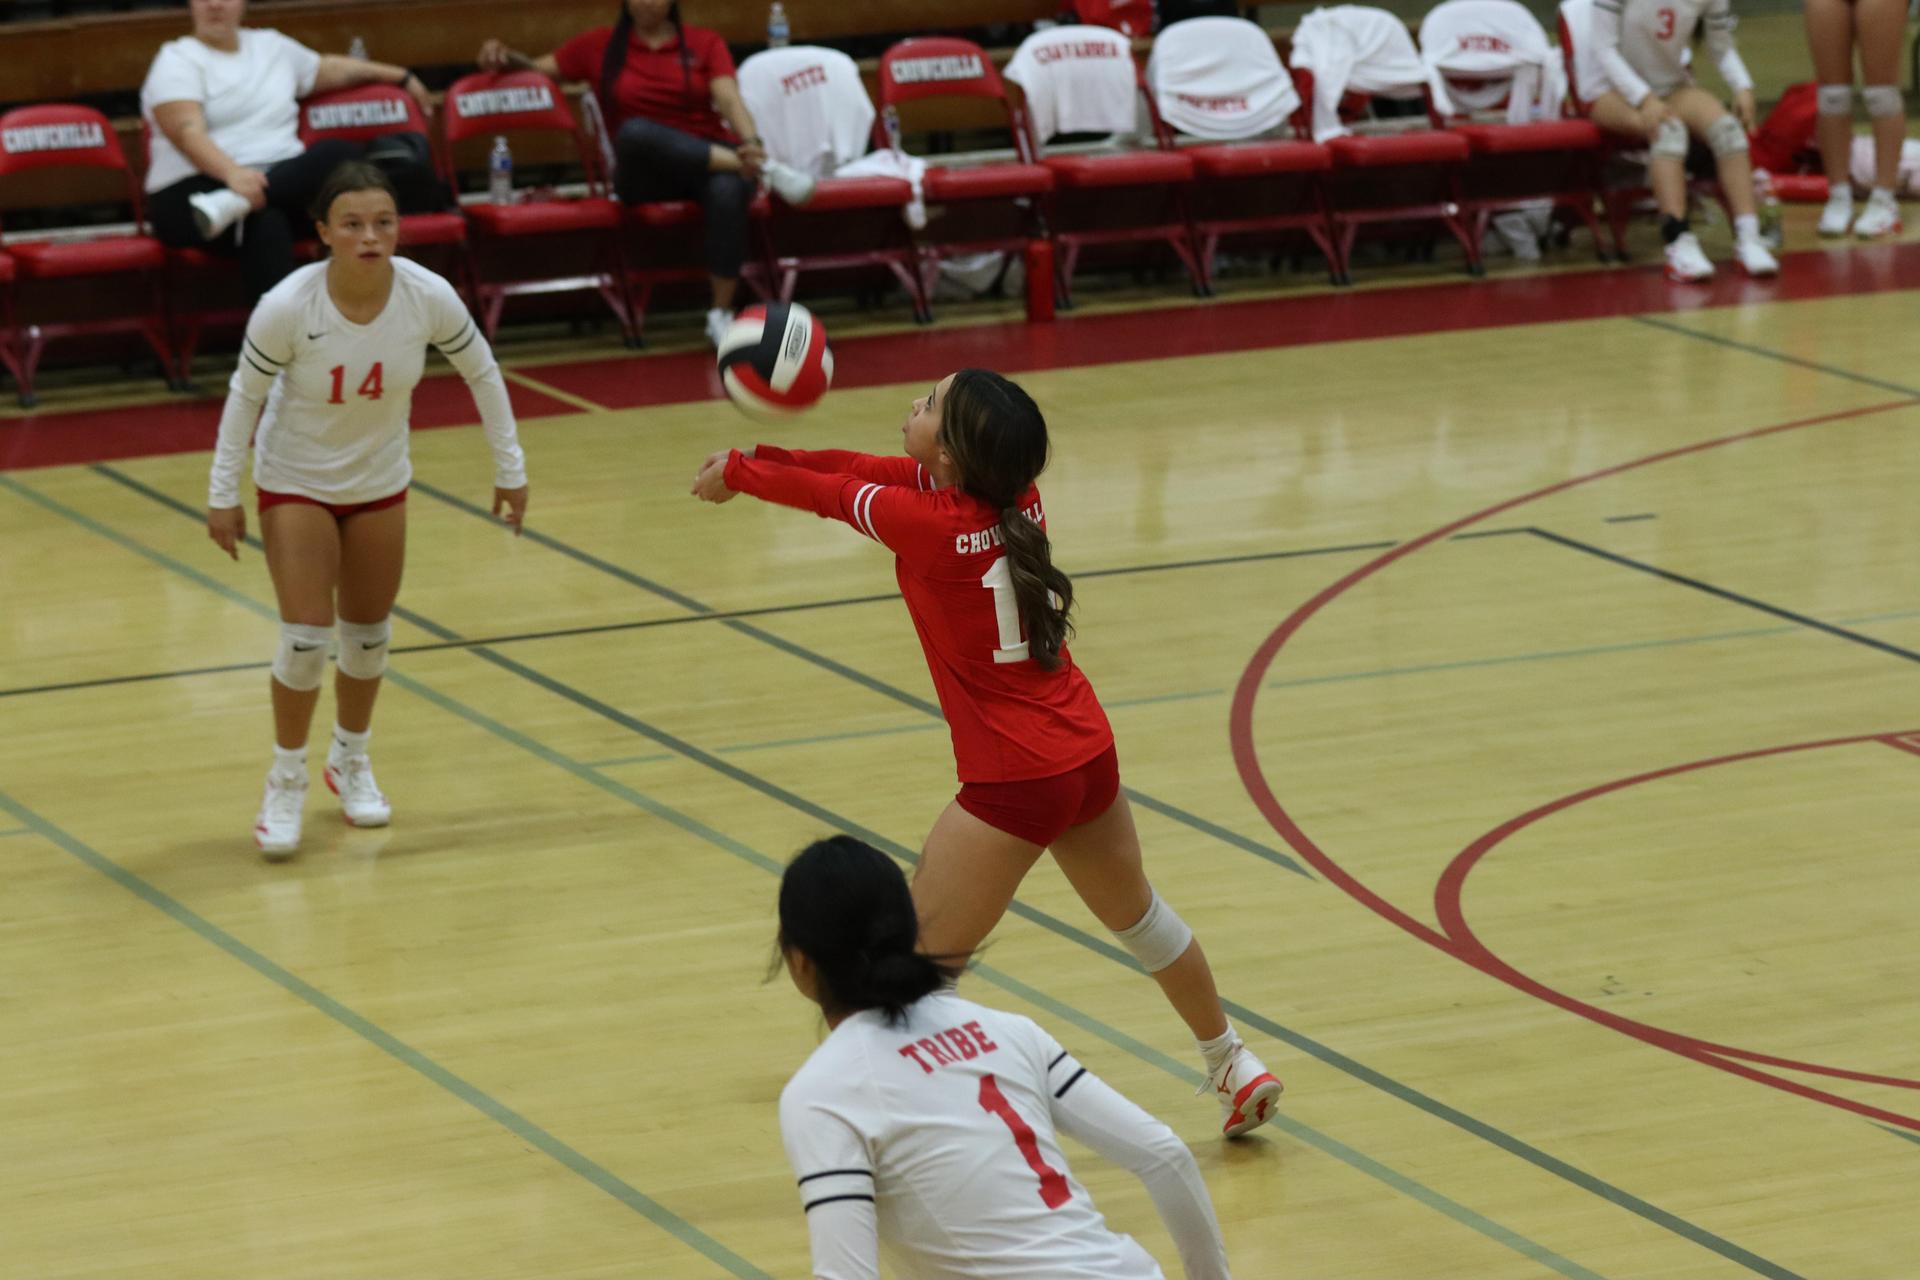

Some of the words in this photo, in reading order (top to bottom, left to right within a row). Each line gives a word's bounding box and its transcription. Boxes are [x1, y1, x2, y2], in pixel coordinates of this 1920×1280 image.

[1656, 7, 1675, 41] 3
[889, 54, 984, 84] CHOWCHILLA
[308, 99, 408, 130] CHOWCHILLA
[455, 87, 554, 117] CHOWCHILLA
[3, 122, 105, 154] CHOWCHILLA
[326, 361, 385, 404] 14
[981, 555, 1057, 664] 1
[899, 1020, 998, 1074] TRIBE
[978, 1073, 1073, 1210] 1
